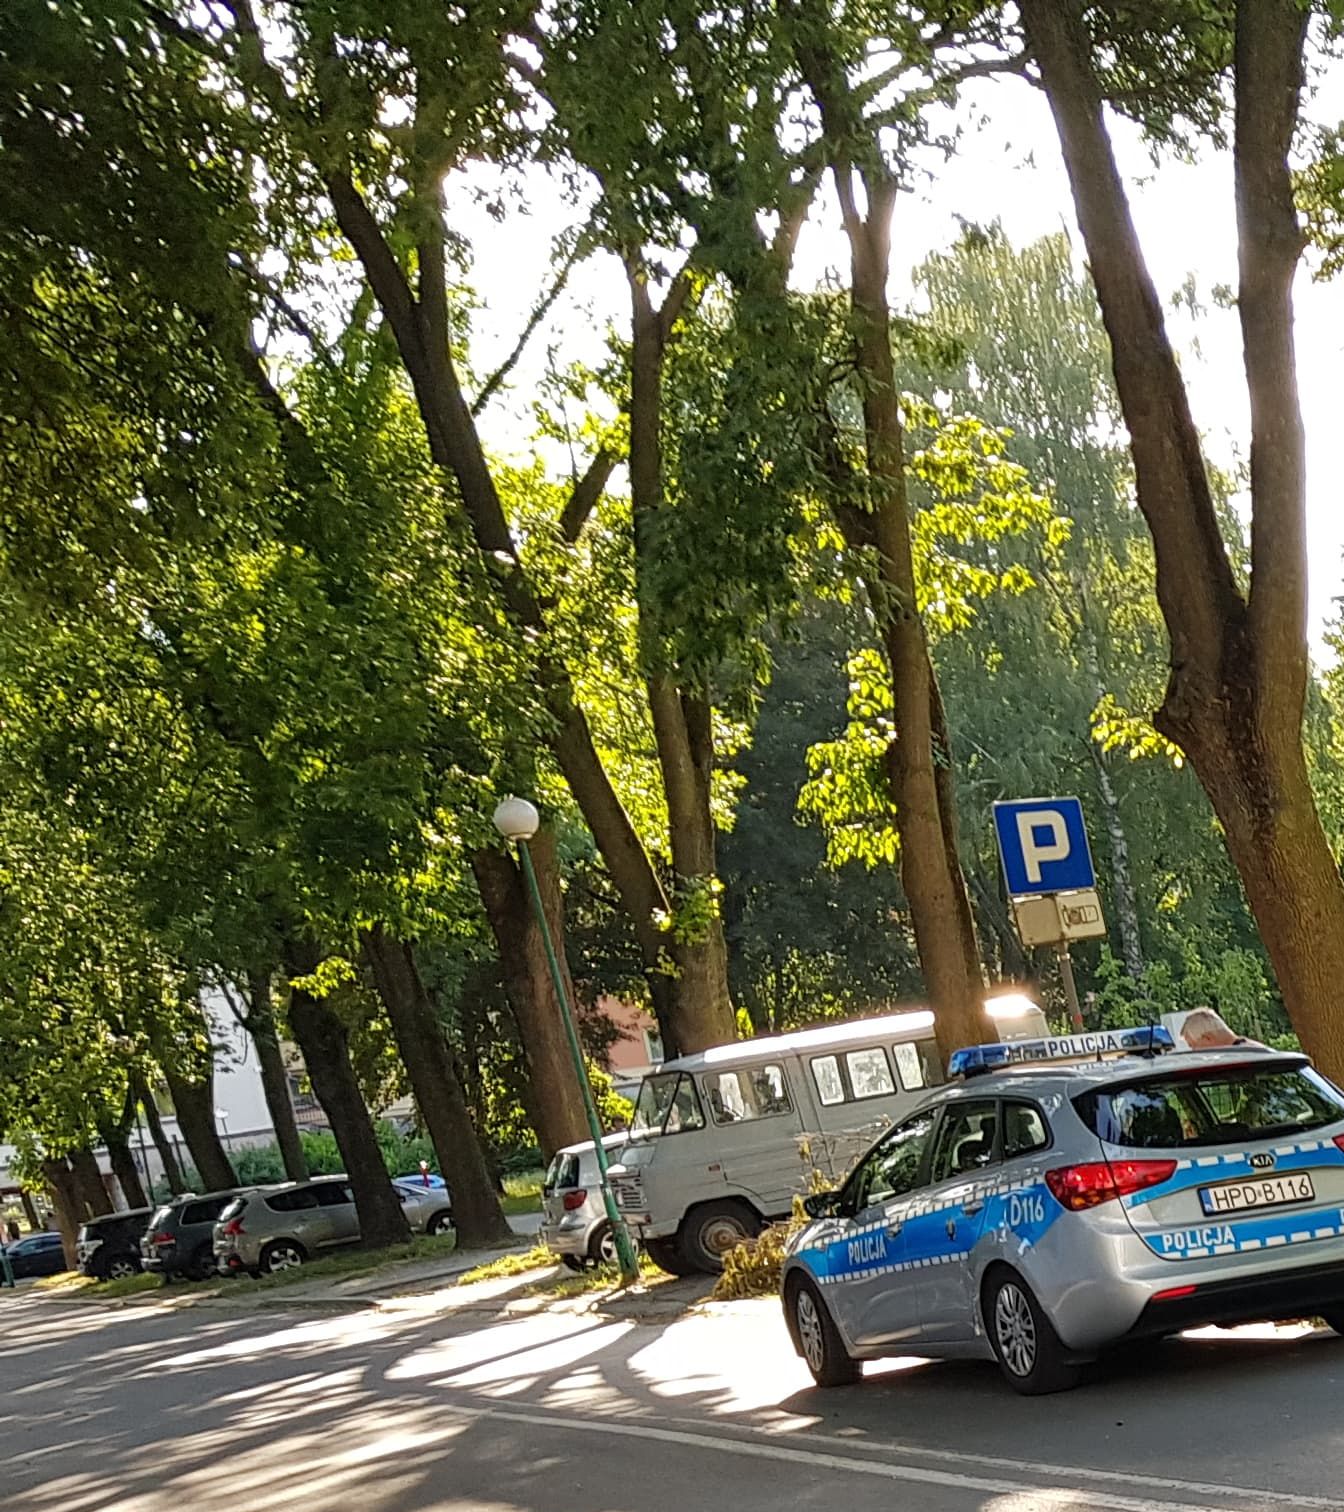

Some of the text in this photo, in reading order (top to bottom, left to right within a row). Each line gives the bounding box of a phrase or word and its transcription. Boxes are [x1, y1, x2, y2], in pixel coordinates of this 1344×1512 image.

[1015, 810, 1070, 884] P
[1046, 1035, 1119, 1057] POLICJA
[1252, 1155, 1273, 1167] KIA
[1213, 1178, 1309, 1209] HPD B116
[1010, 1195, 1045, 1226] D116
[848, 1234, 887, 1266] POLICJA
[1162, 1226, 1235, 1251] POLICJA
